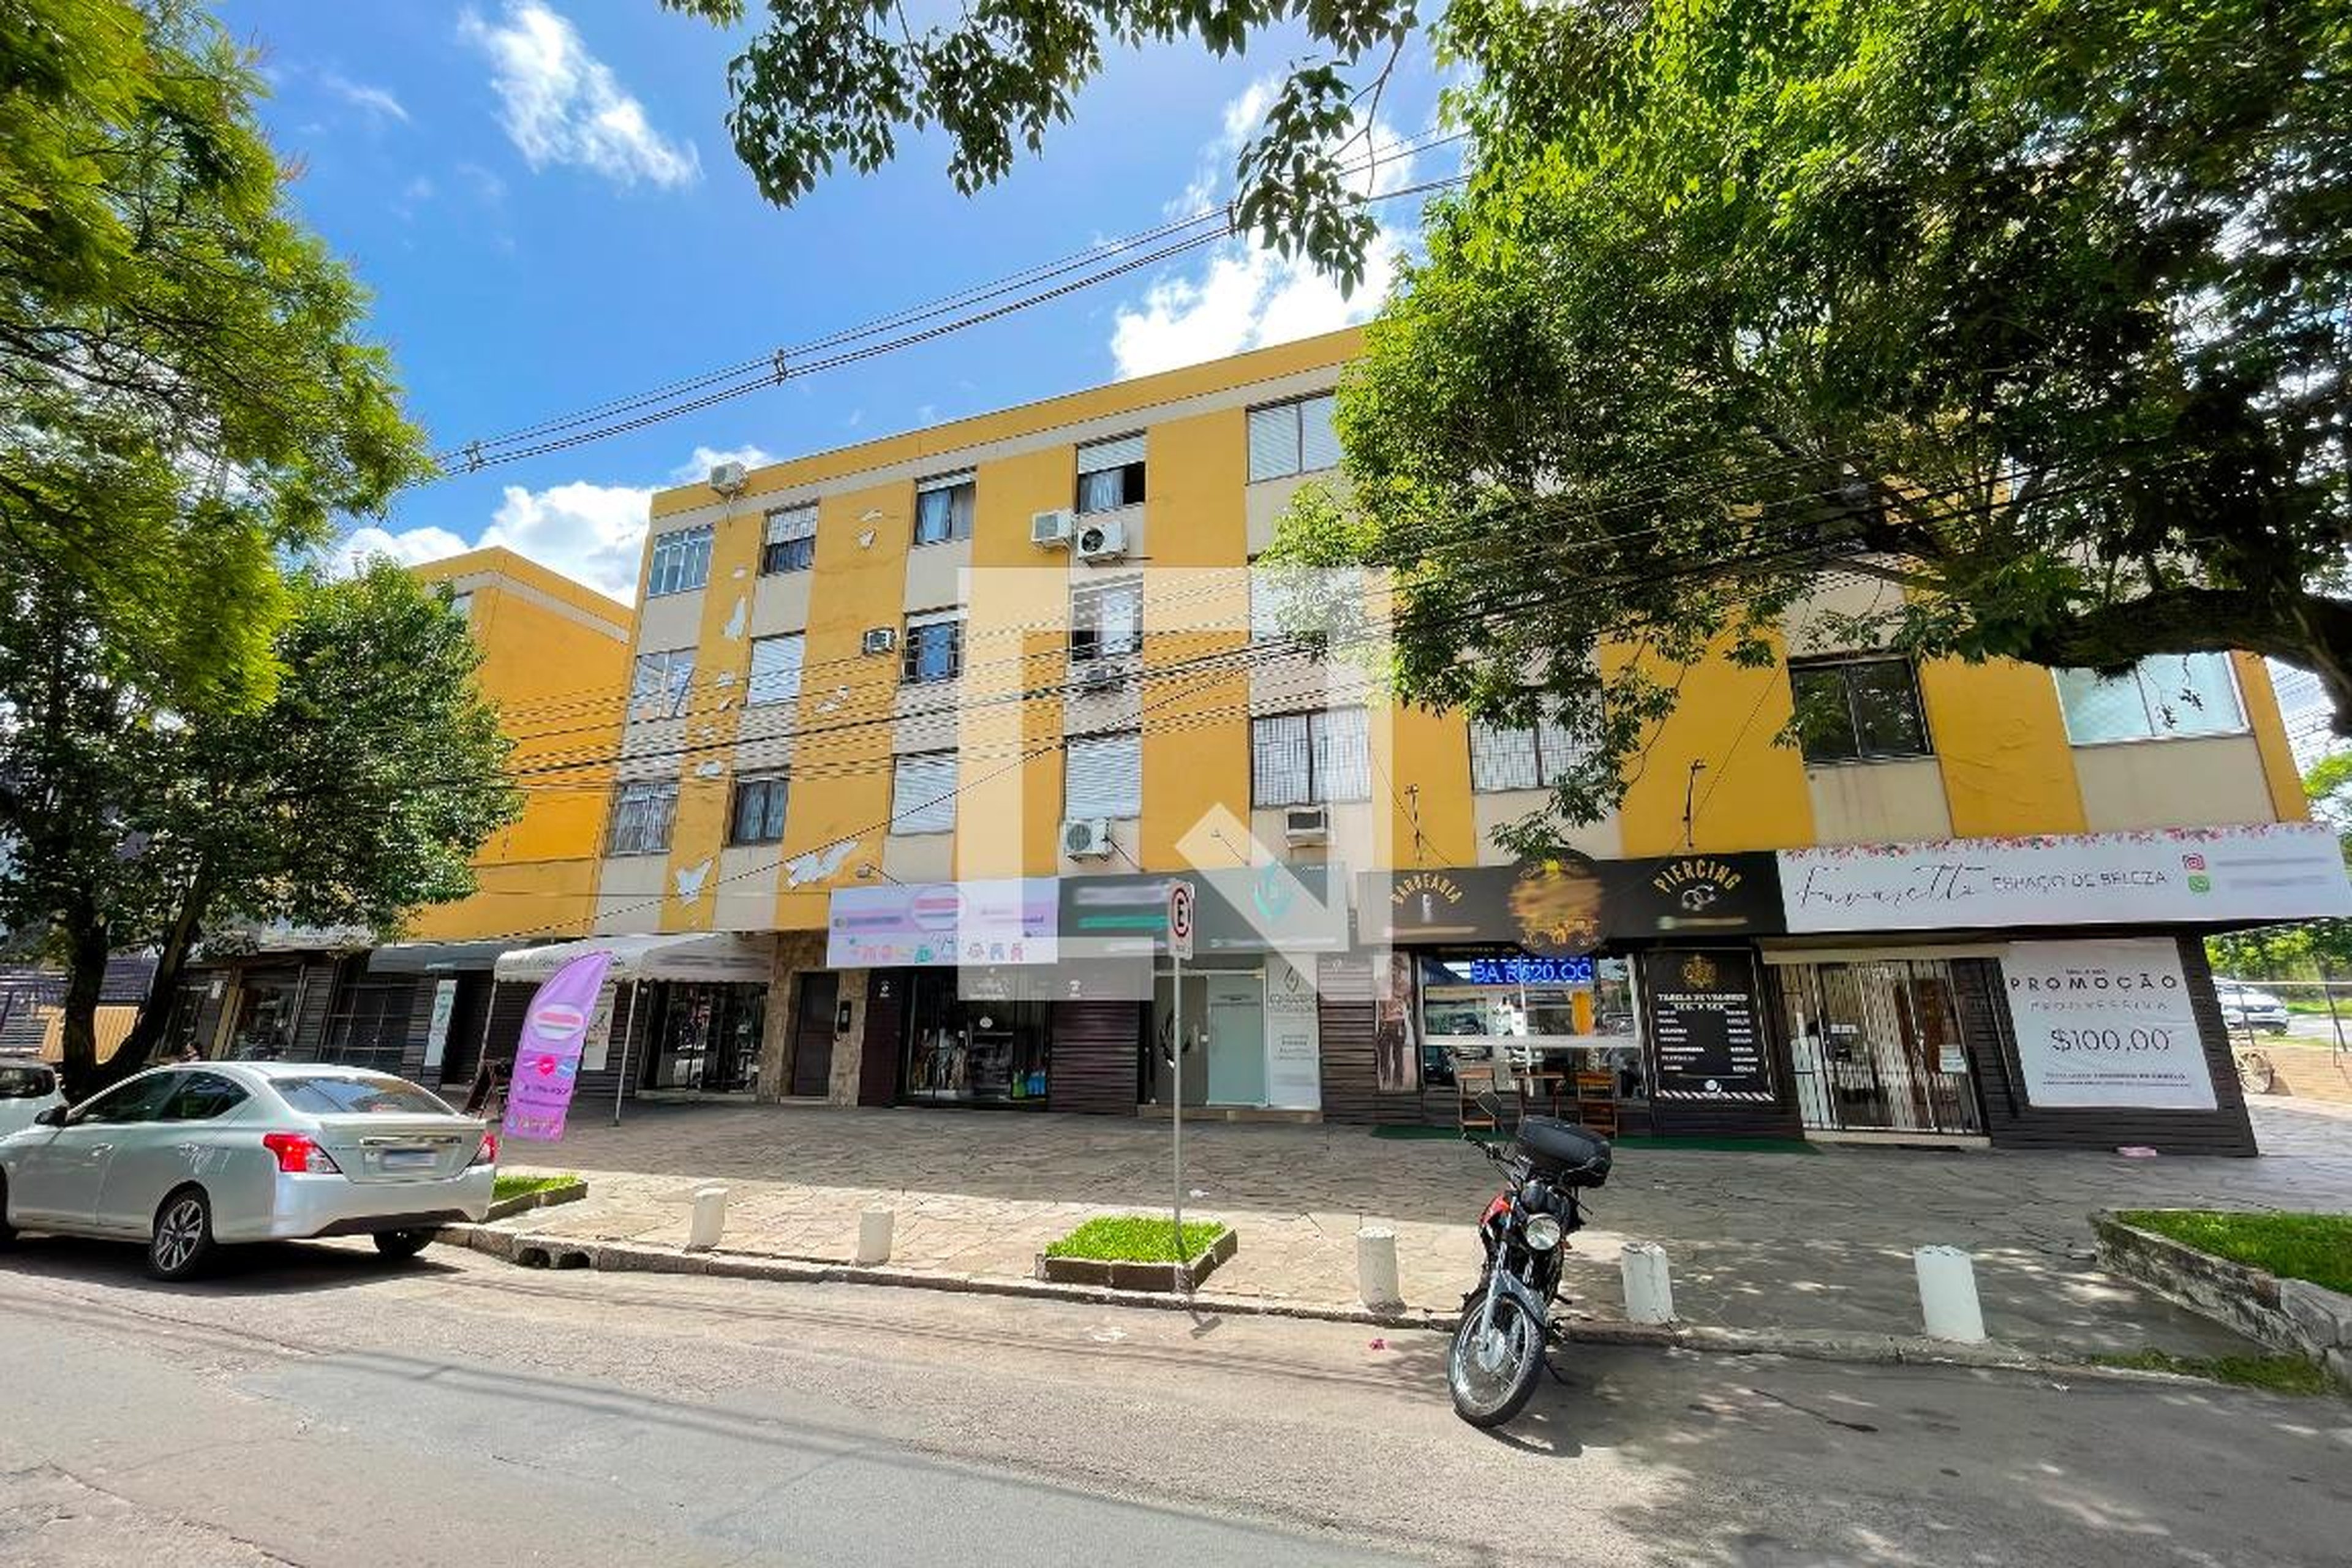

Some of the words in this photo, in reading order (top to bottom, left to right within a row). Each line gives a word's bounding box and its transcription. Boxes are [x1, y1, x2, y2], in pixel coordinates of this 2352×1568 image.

[1654, 859, 1741, 894] PIERCING
[1992, 875, 2065, 892] ESPAÇO
[2071, 873, 2096, 887] DE
[2100, 870, 2168, 885] BELEZA
[2010, 974, 2177, 992] PROMOÇÃO
